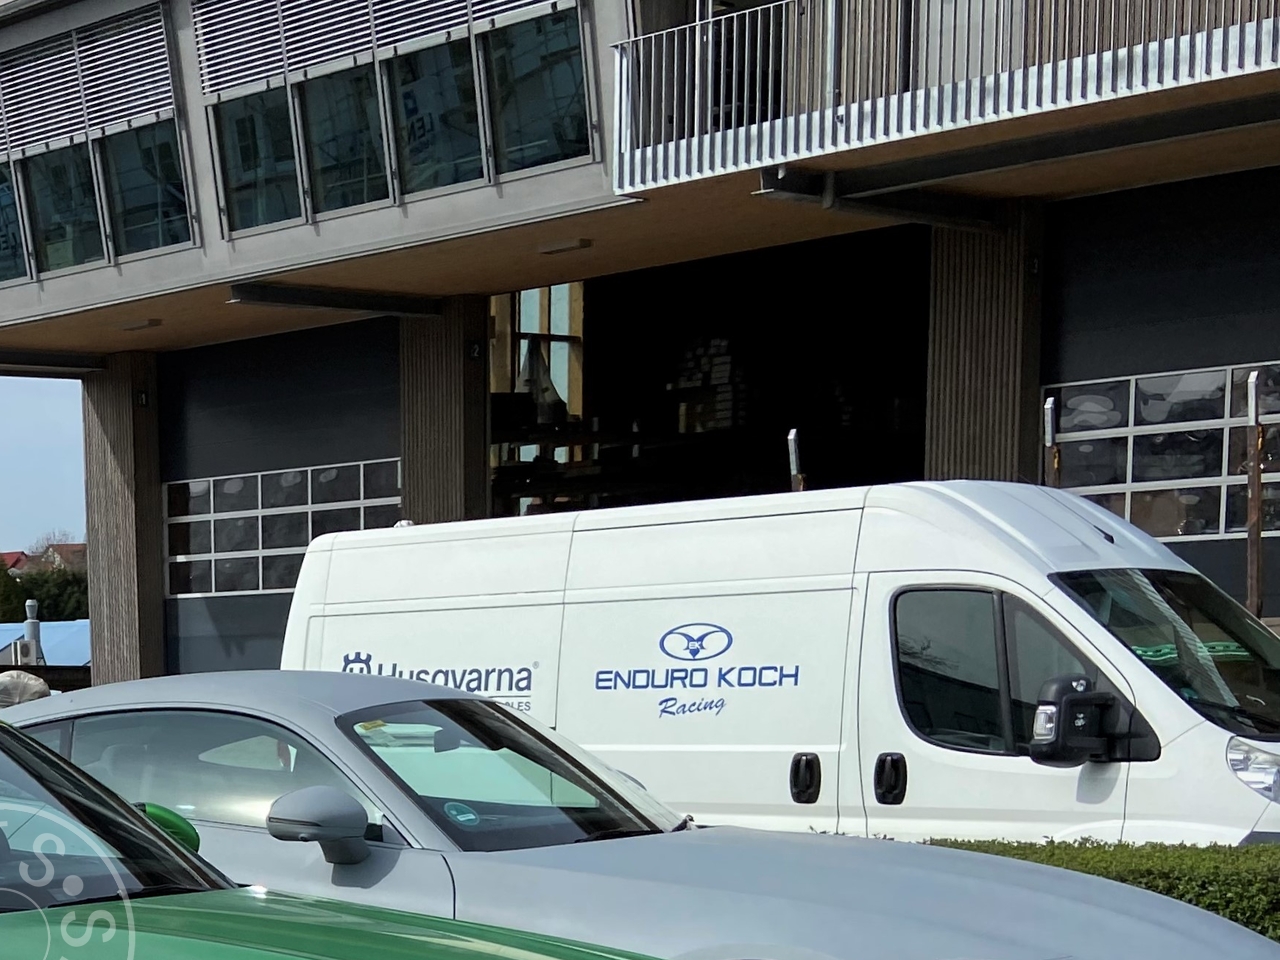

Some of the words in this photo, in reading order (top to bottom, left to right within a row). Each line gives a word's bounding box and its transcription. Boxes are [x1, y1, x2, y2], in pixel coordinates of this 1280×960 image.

[595, 668, 709, 690] ENDURO
[717, 665, 800, 688] KOCH
[658, 697, 727, 719] Racing
